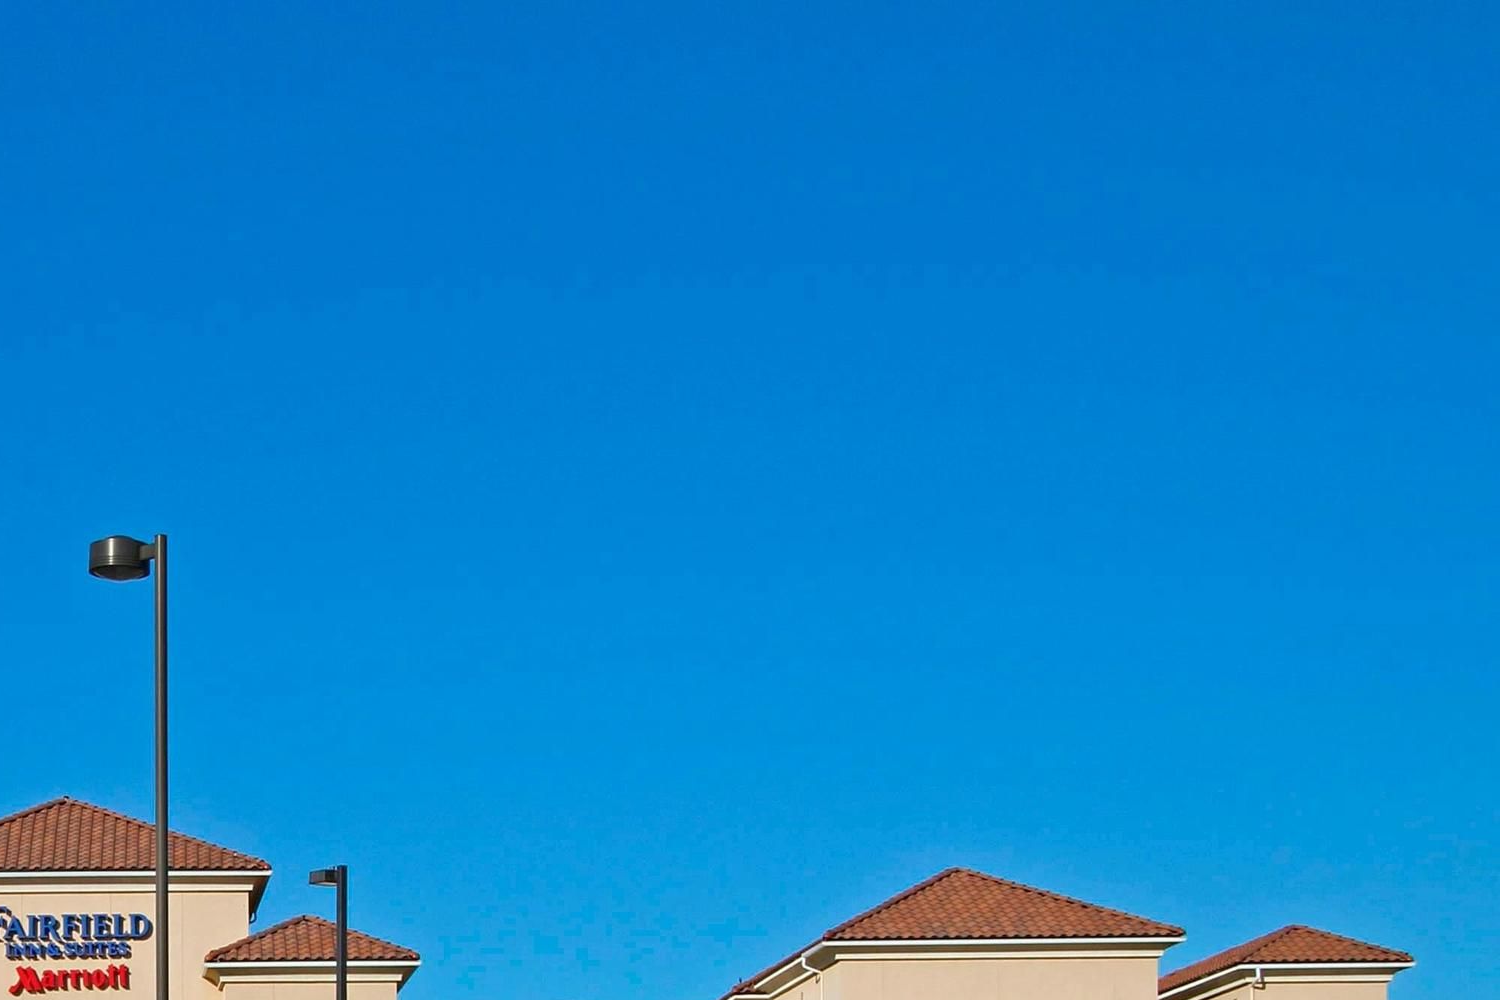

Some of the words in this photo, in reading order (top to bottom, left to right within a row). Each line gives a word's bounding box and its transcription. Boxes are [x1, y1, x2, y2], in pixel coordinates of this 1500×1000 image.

[5, 943, 46, 960] INN
[47, 942, 65, 960] &
[64, 941, 132, 960] SUITES
[8, 963, 131, 996] Marriott
